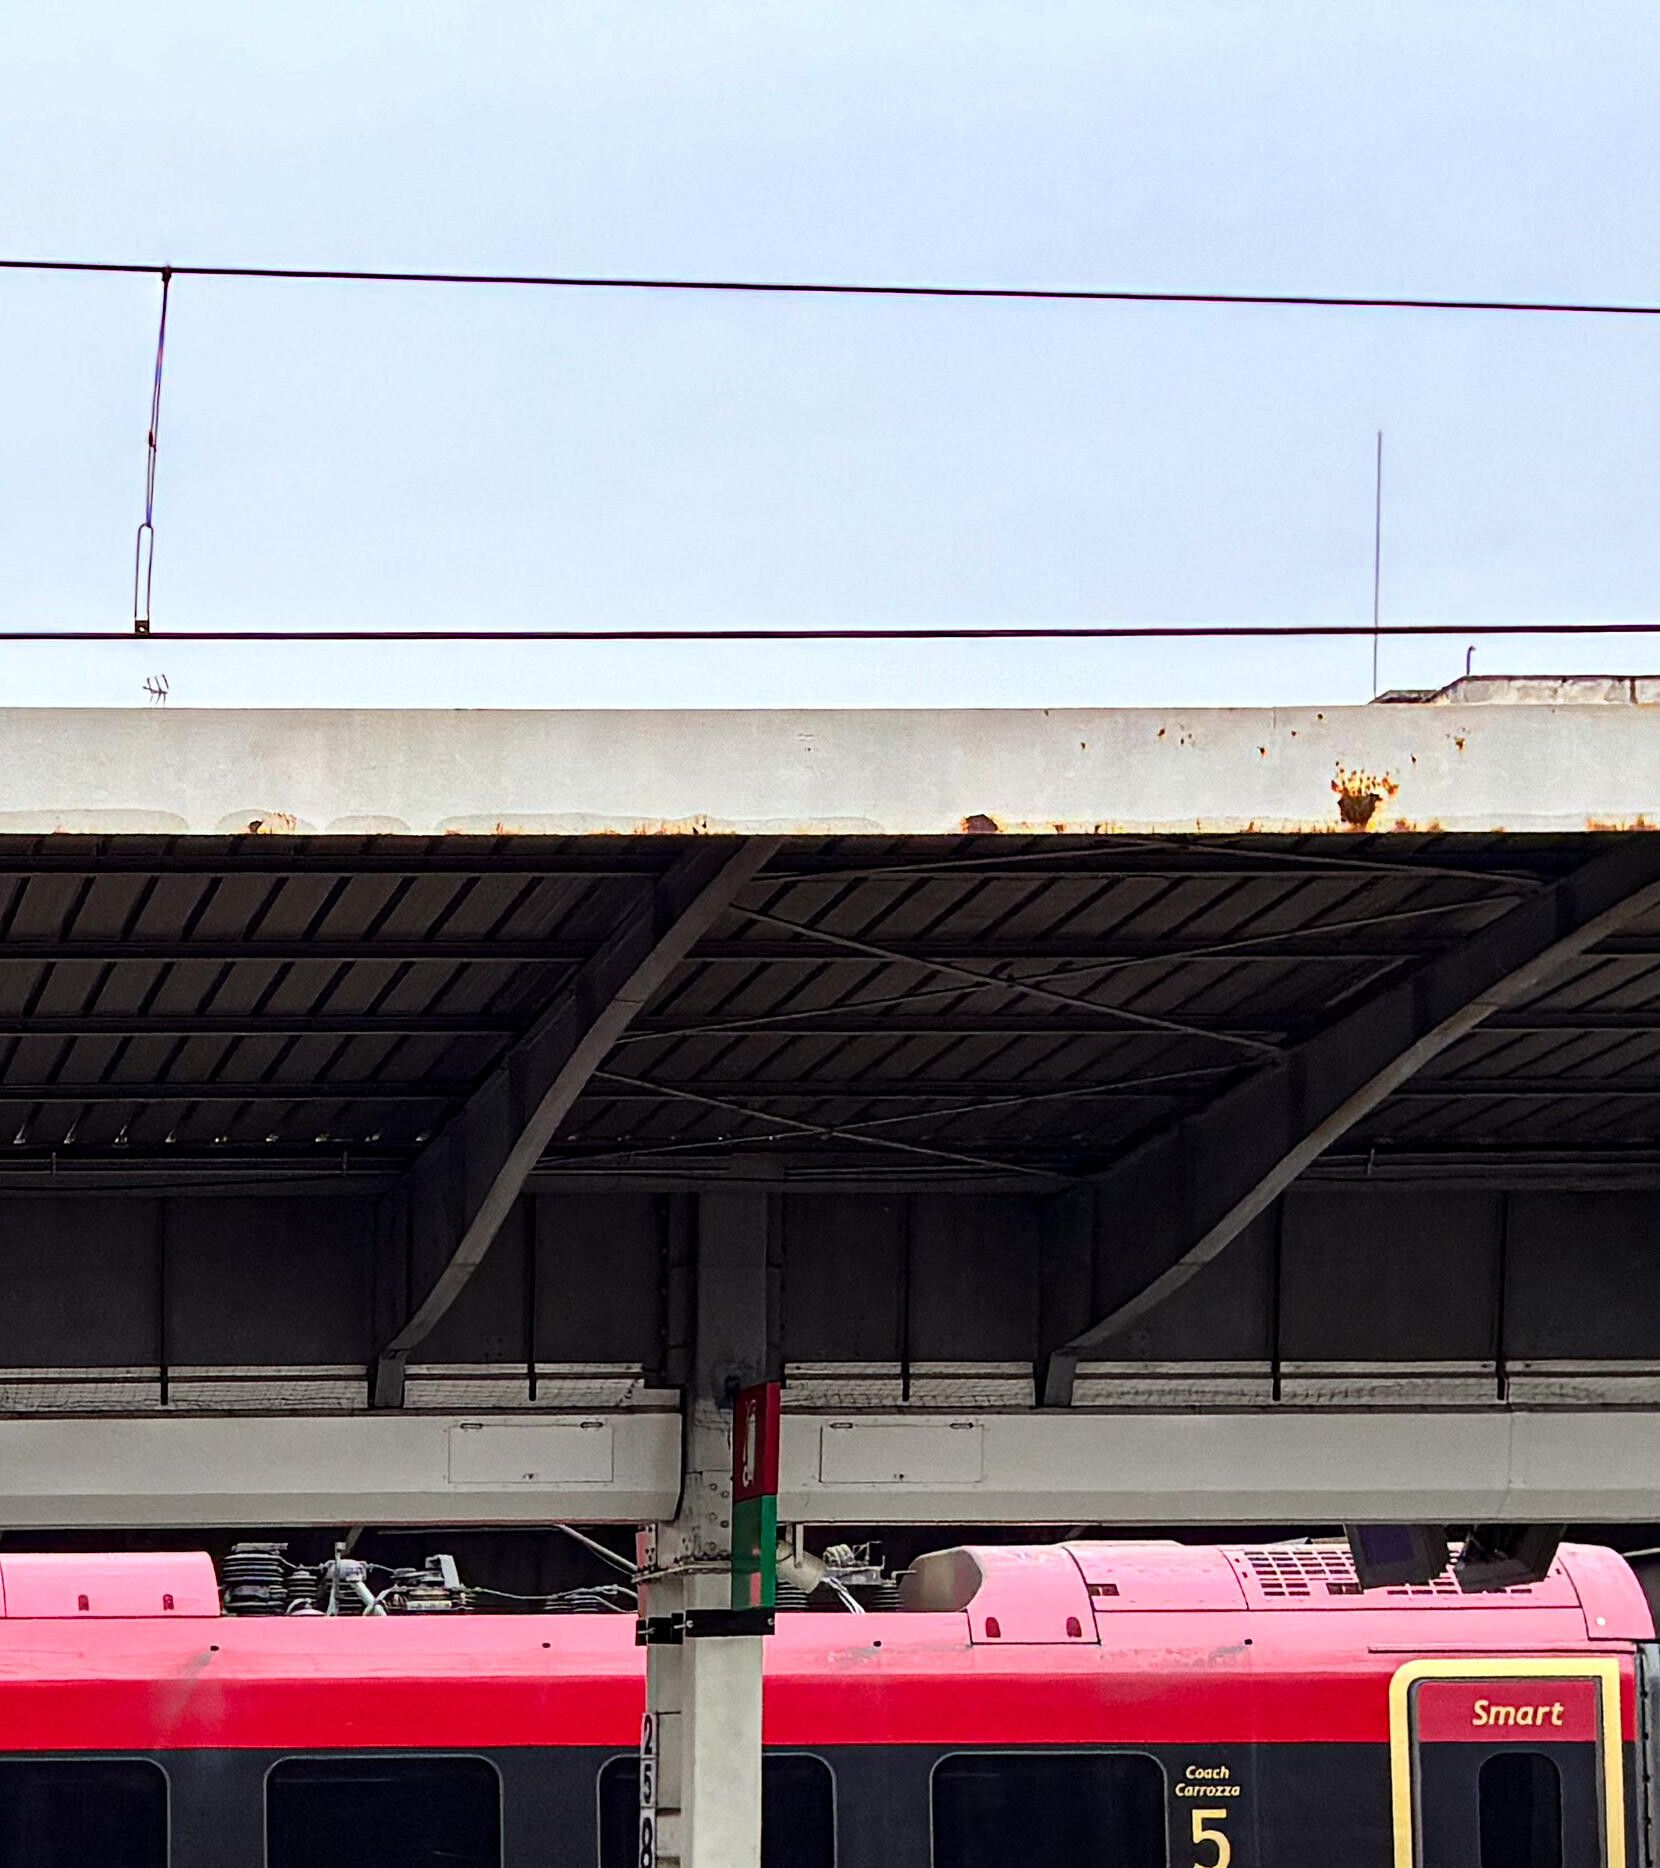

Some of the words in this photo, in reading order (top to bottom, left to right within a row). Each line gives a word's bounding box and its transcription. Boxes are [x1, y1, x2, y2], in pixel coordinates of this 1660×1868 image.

[1472, 1699, 1564, 1727] Smart
[1185, 1765, 1229, 1780] Coach
[1175, 1782, 1241, 1797] Carrozza
